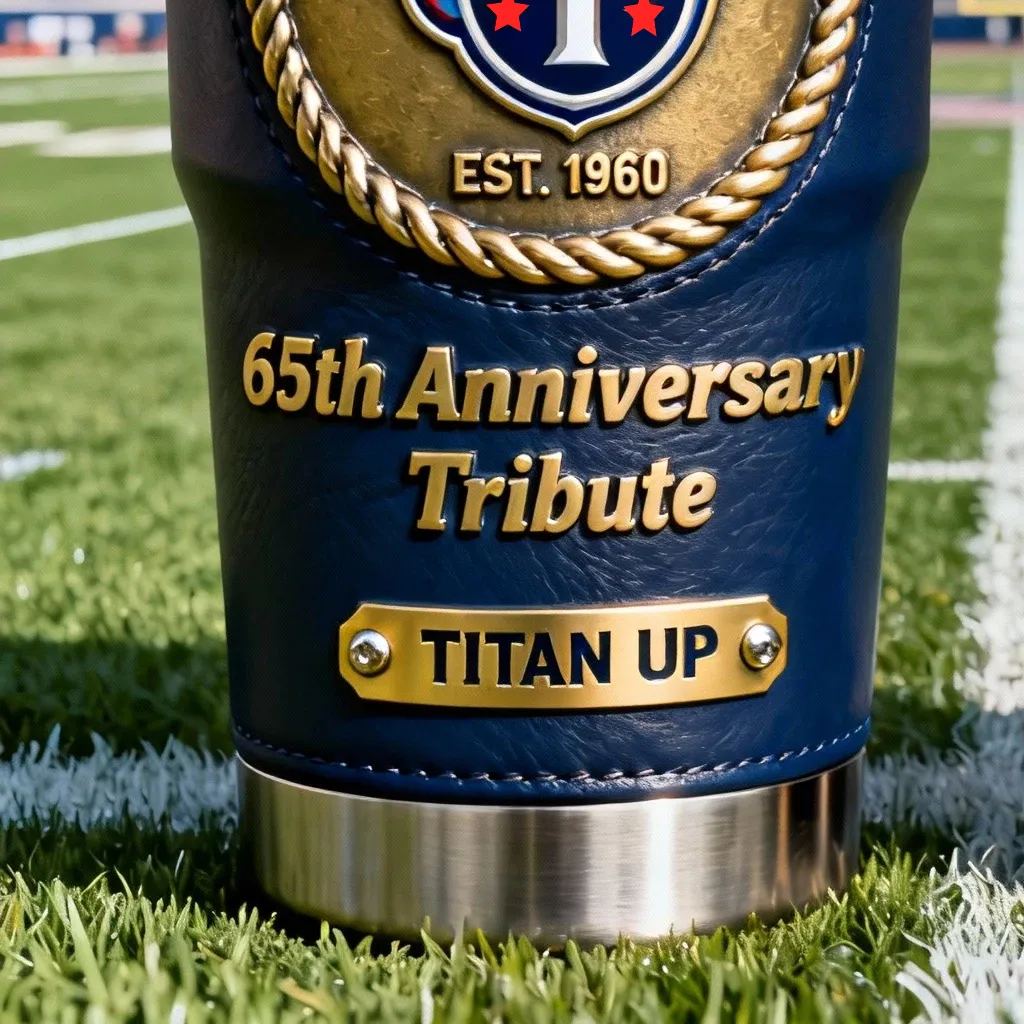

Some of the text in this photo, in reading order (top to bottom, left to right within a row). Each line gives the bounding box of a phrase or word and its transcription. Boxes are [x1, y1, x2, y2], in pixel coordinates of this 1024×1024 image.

[452, 150, 670, 198] EST. 1960
[242, 331, 865, 430] 65th Anniversary
[408, 449, 718, 536] Tribute
[420, 624, 719, 689] TITAN UP
